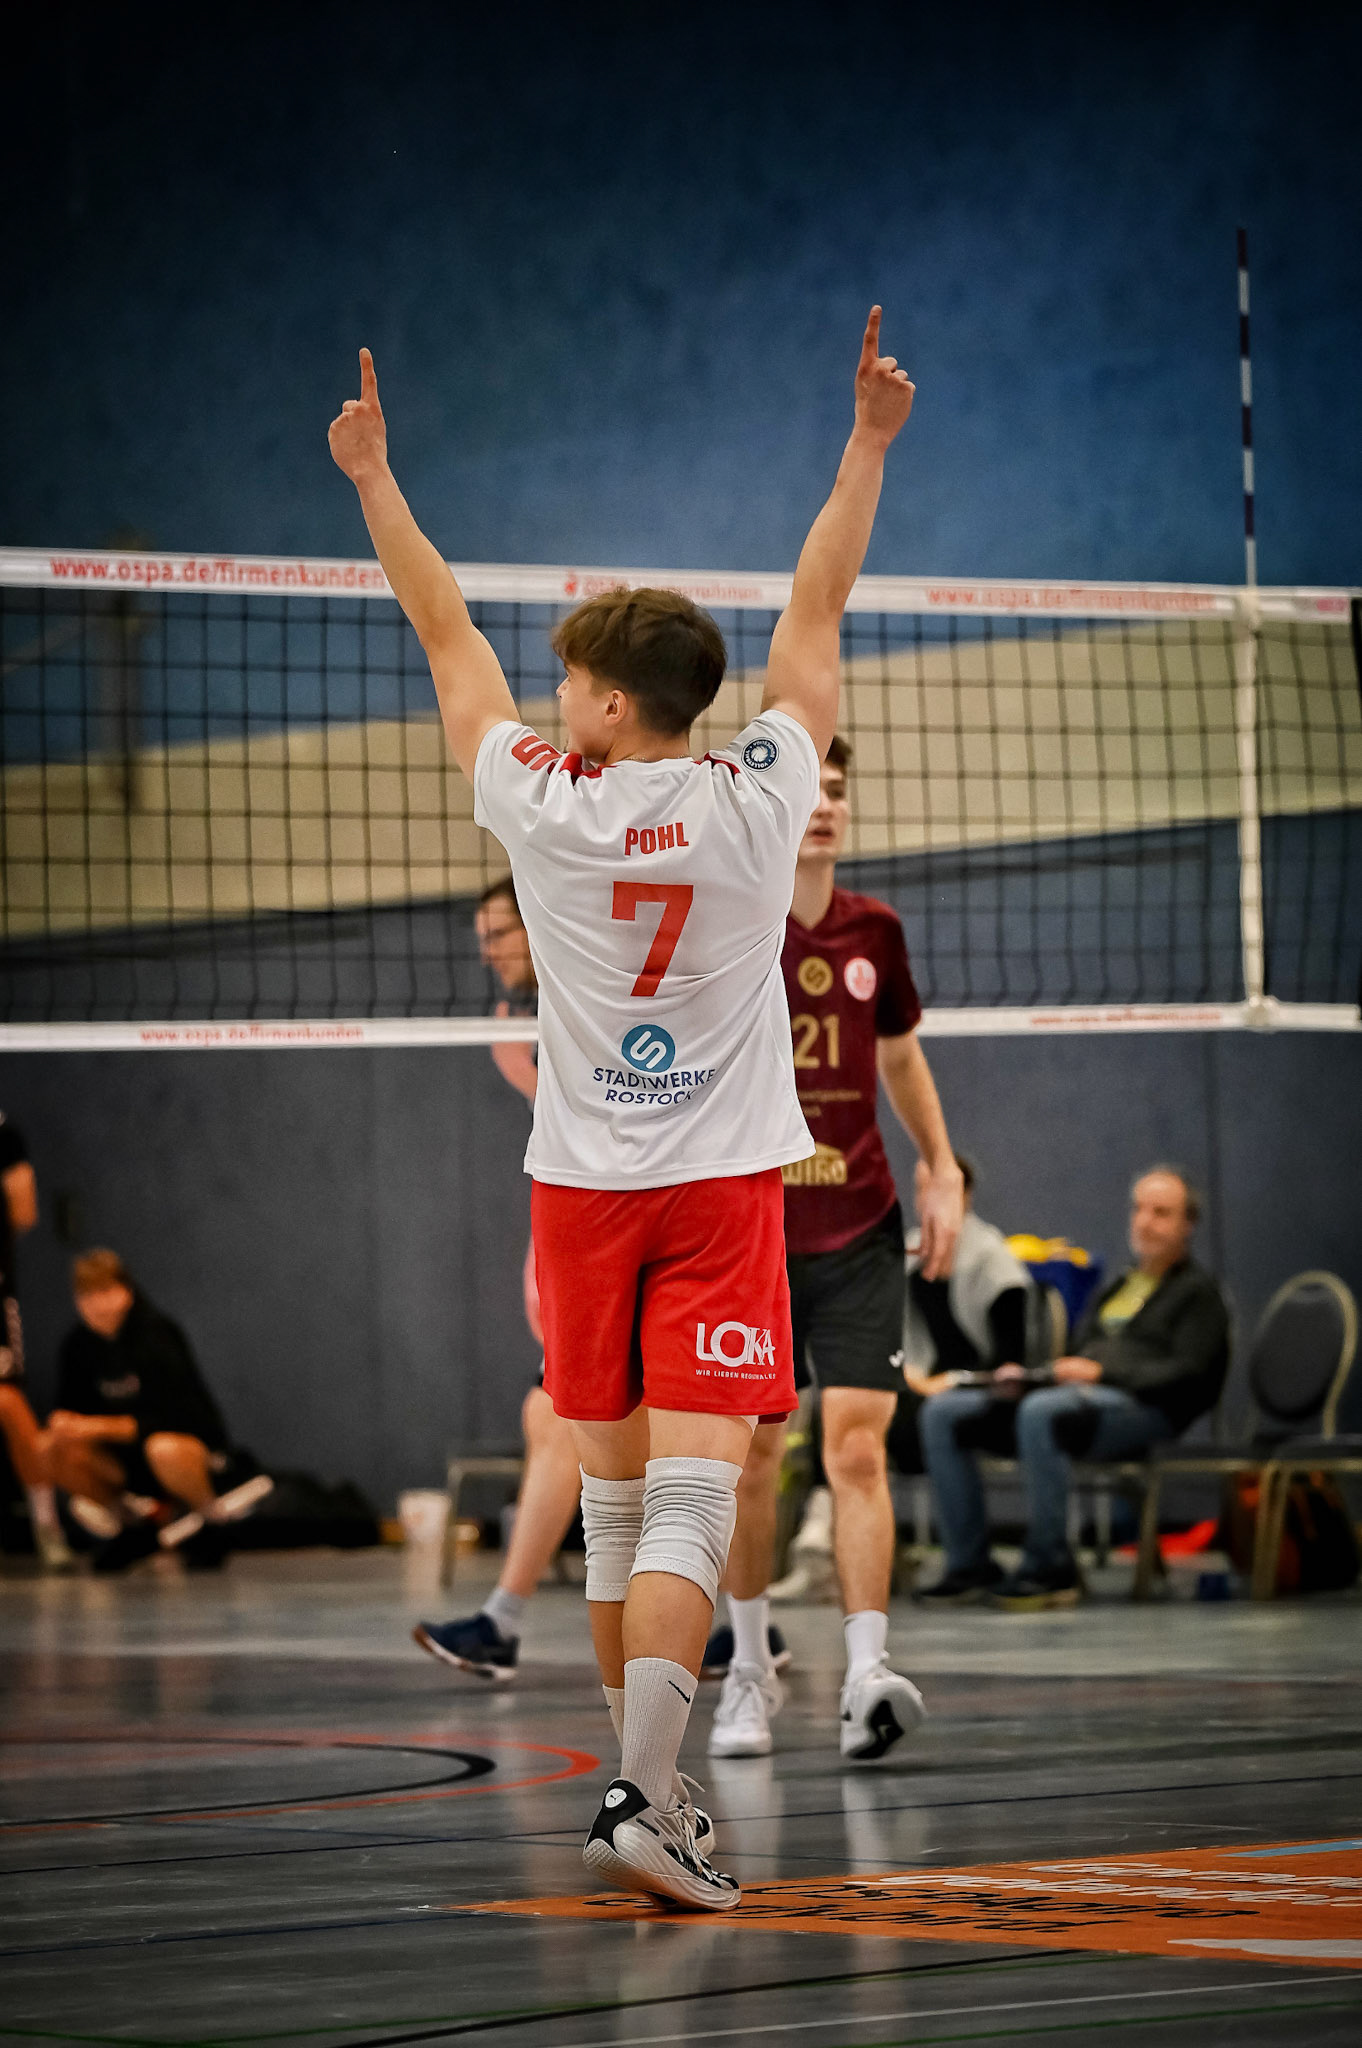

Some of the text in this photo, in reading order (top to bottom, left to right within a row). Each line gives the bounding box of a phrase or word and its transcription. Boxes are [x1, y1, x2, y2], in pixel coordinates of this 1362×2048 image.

[624, 821, 690, 857] POHL
[611, 880, 694, 998] 7
[792, 1012, 841, 1070] 21
[592, 1067, 716, 1090] STADTWERKE
[605, 1088, 697, 1105] ROSTOCK
[695, 1320, 776, 1368] LOKA
[695, 1369, 711, 1377] WIR
[713, 1370, 739, 1379] LIEBEN
[582, 1897, 1130, 1933] erlybird.
[741, 1884, 1261, 1919] OSPAgiro
